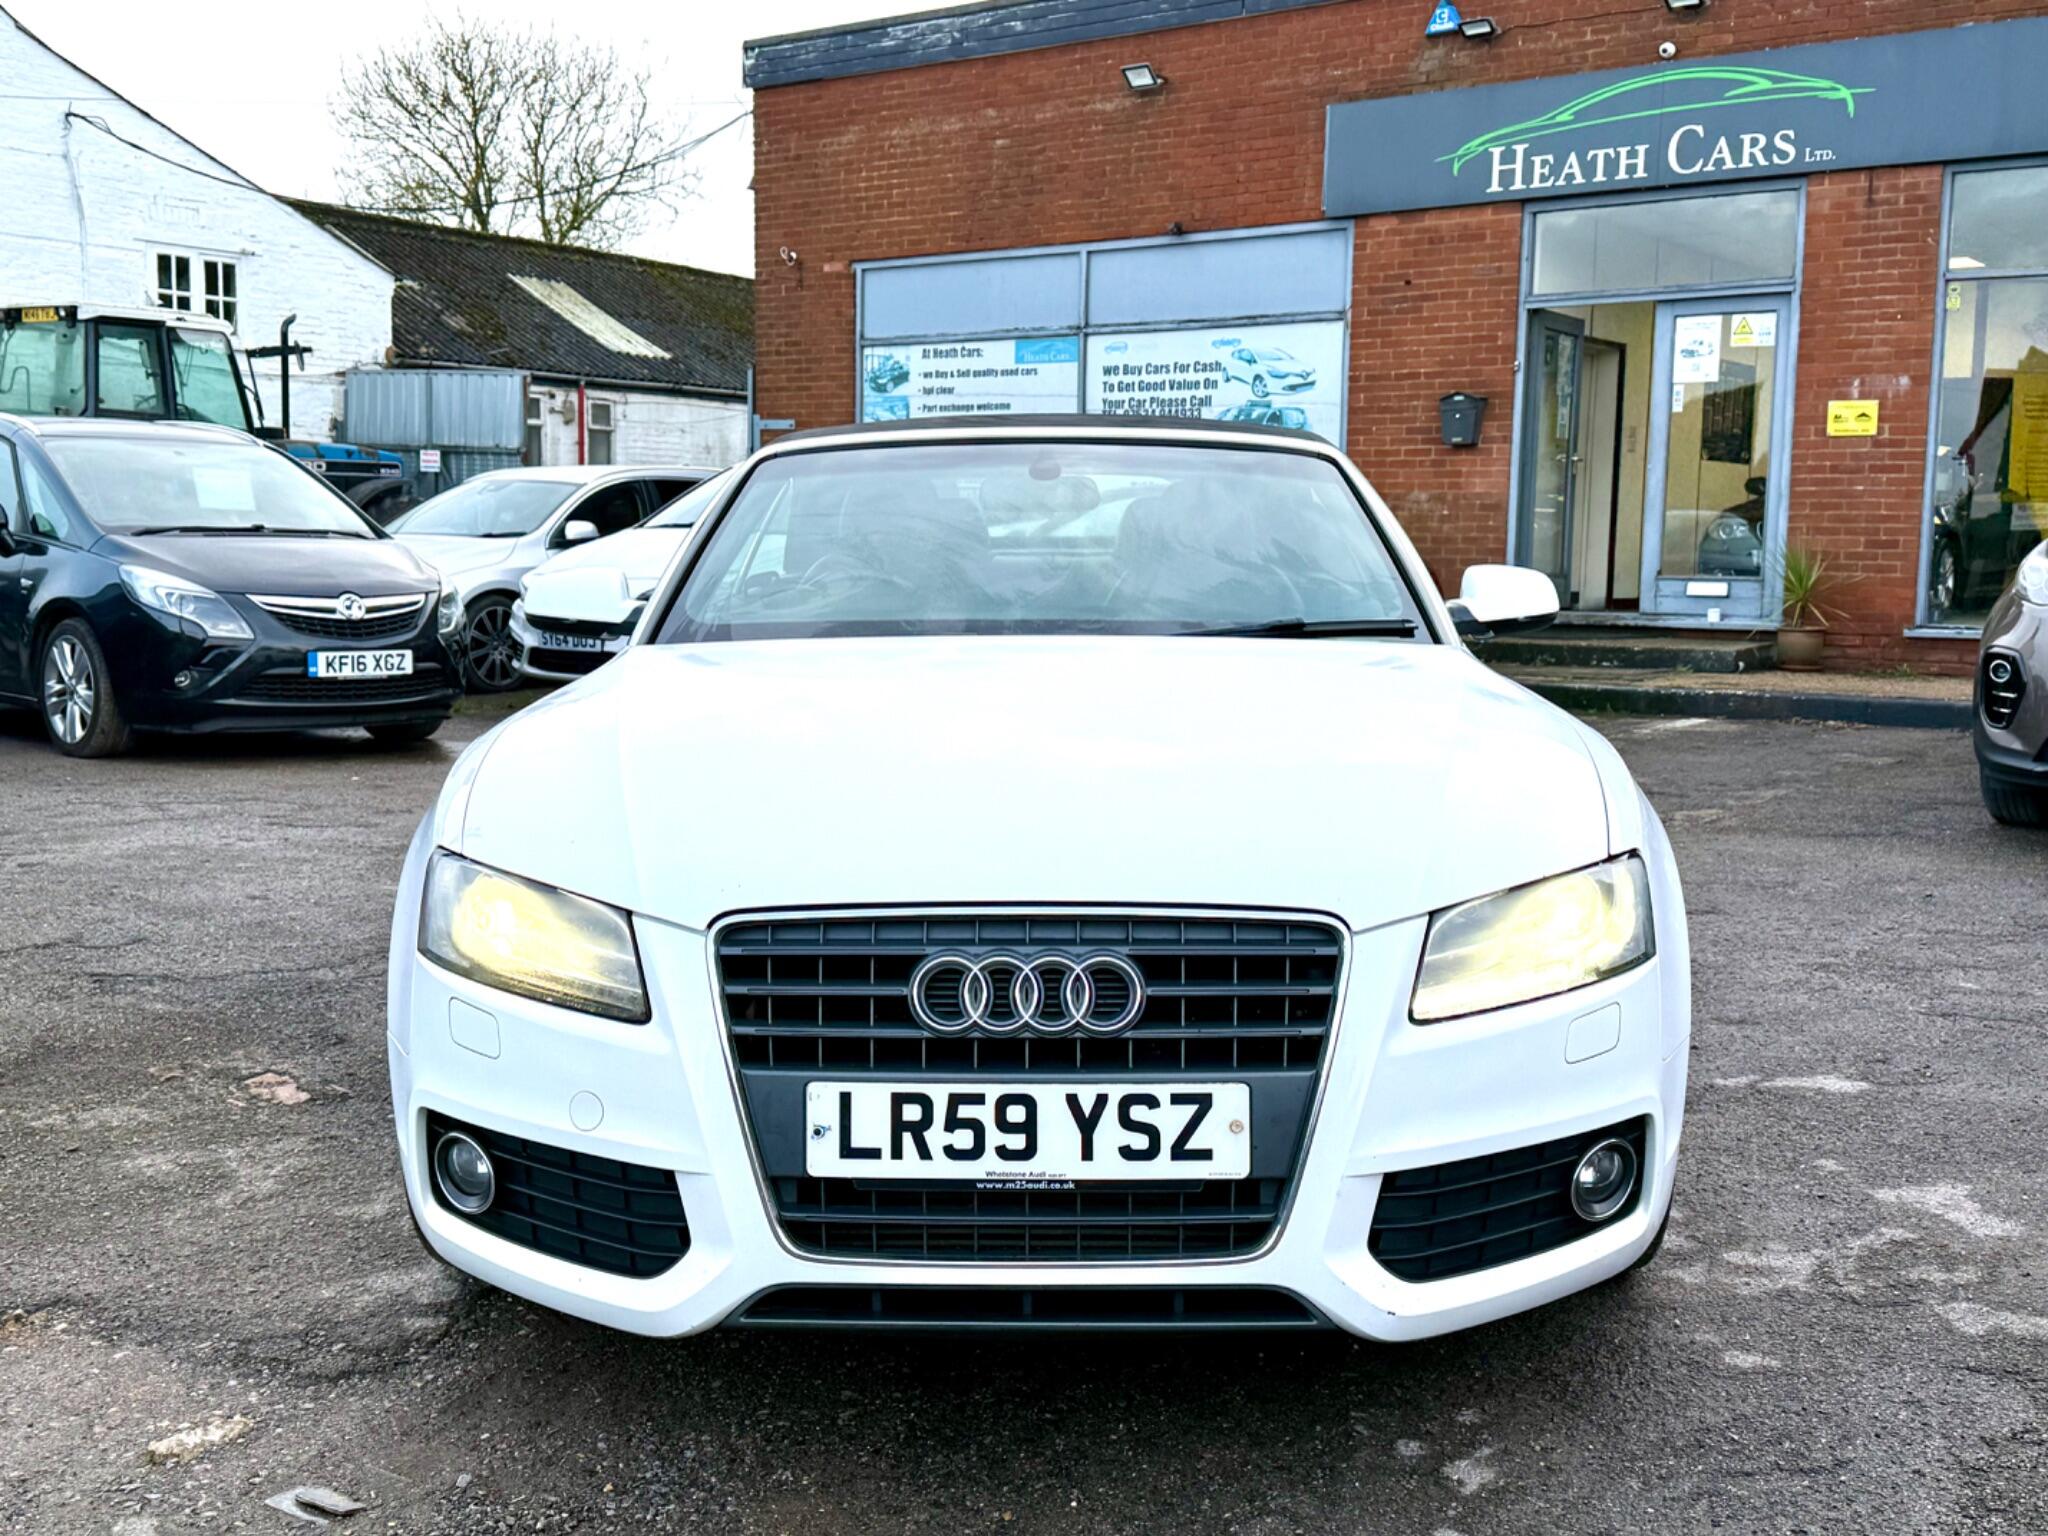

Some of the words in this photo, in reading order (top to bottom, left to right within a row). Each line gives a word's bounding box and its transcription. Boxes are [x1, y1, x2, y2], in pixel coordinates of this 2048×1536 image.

[1486, 143, 1650, 193] HEATH
[1667, 124, 1798, 175] CARS
[922, 348, 931, 360] At
[932, 347, 959, 360] Heath
[960, 346, 984, 359] Cars:
[935, 370, 949, 380] Buy
[957, 368, 971, 378] Sell
[972, 368, 998, 379] quality
[1000, 367, 1019, 377] used
[1020, 367, 1038, 377] cars
[1122, 363, 1143, 377] Buy
[1145, 362, 1171, 375] Cars
[1173, 361, 1190, 374] For
[1193, 360, 1222, 373] Cash
[936, 385, 955, 395] clear
[1102, 381, 1115, 393] To
[1117, 380, 1135, 393] Get
[1138, 379, 1166, 392] Good
[1168, 378, 1200, 391] Value
[1203, 377, 1218, 390] On
[922, 403, 937, 412] Part
[938, 402, 975, 412] exchange
[976, 401, 1011, 411] welcome
[1102, 397, 1125, 409] Your
[1128, 396, 1146, 409] Car
[1149, 395, 1187, 408] Please
[1189, 394, 1212, 407] Call
[325, 655, 367, 673] KF16
[372, 653, 406, 672] XGZ
[838, 1092, 1039, 1161] LR59
[1065, 1092, 1214, 1162] YSZ
